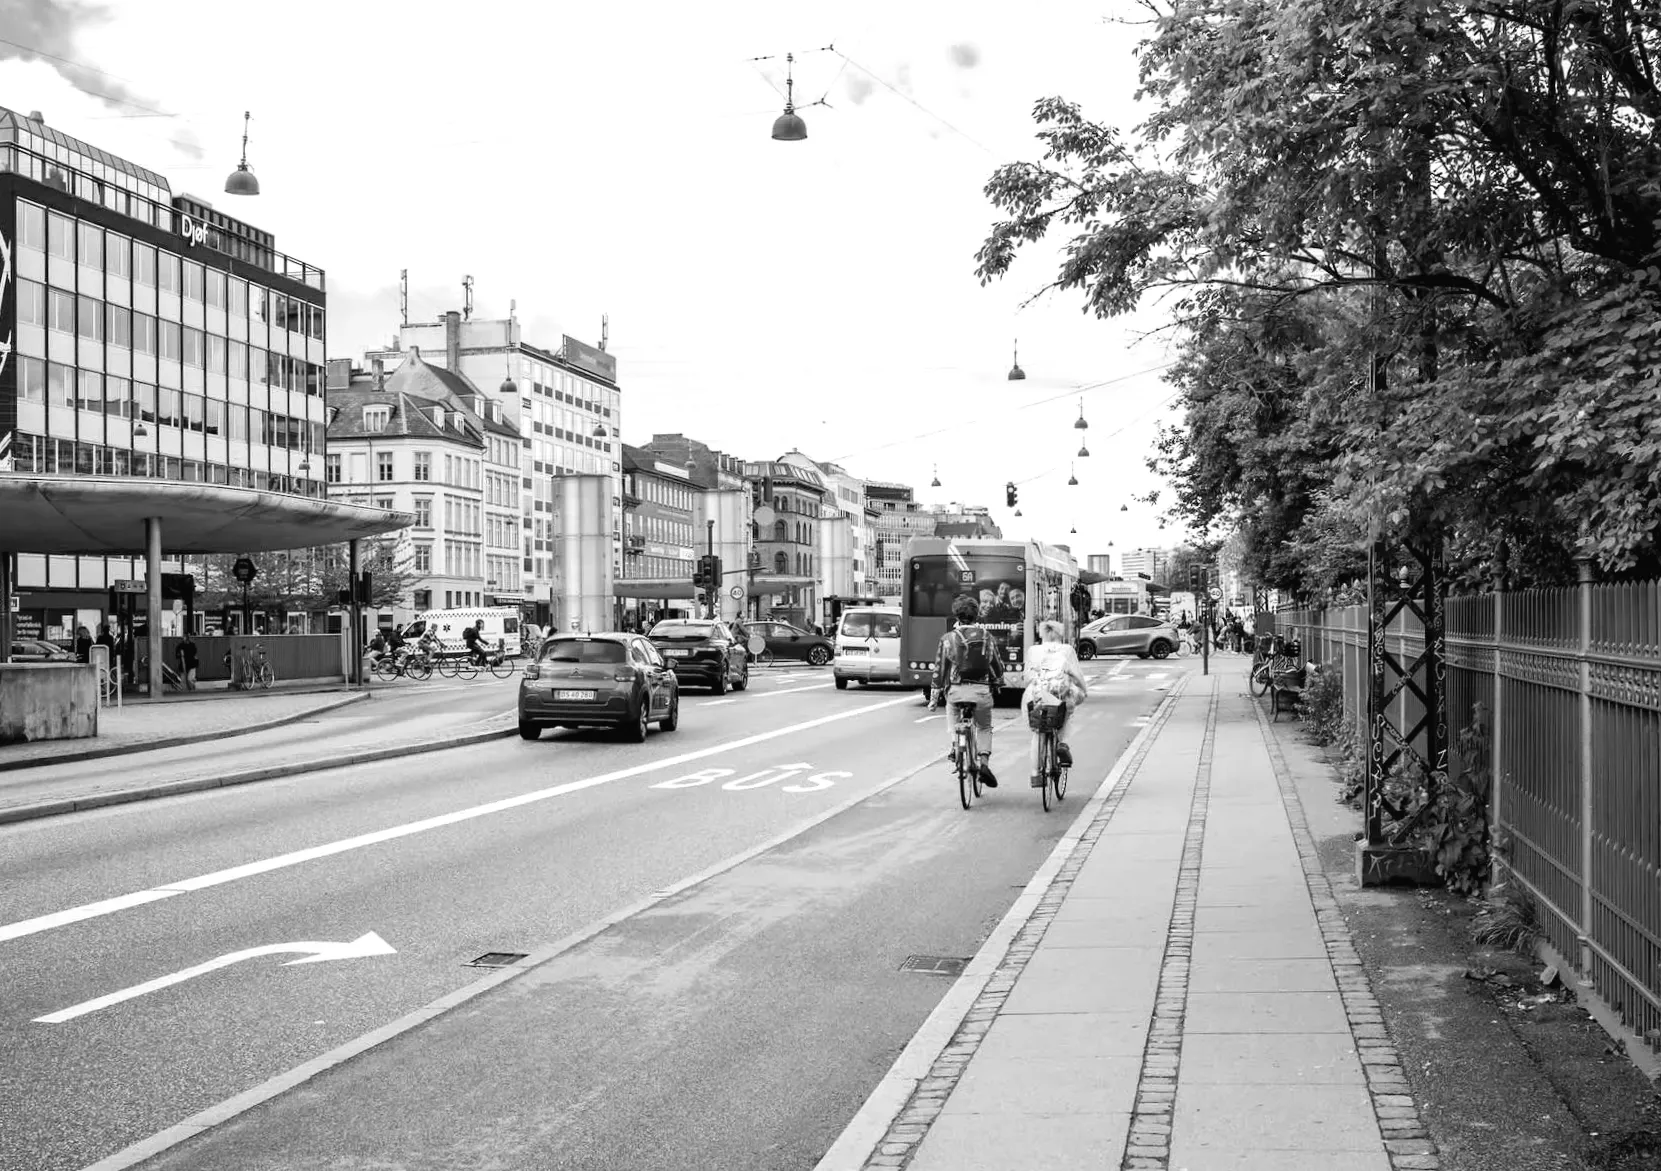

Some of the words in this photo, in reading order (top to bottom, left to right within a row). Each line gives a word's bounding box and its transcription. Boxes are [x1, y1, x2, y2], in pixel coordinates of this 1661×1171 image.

[181, 214, 208, 247] Djøf
[962, 572, 973, 582] 6A
[974, 621, 1018, 632] temning
[647, 768, 853, 793] BUS
